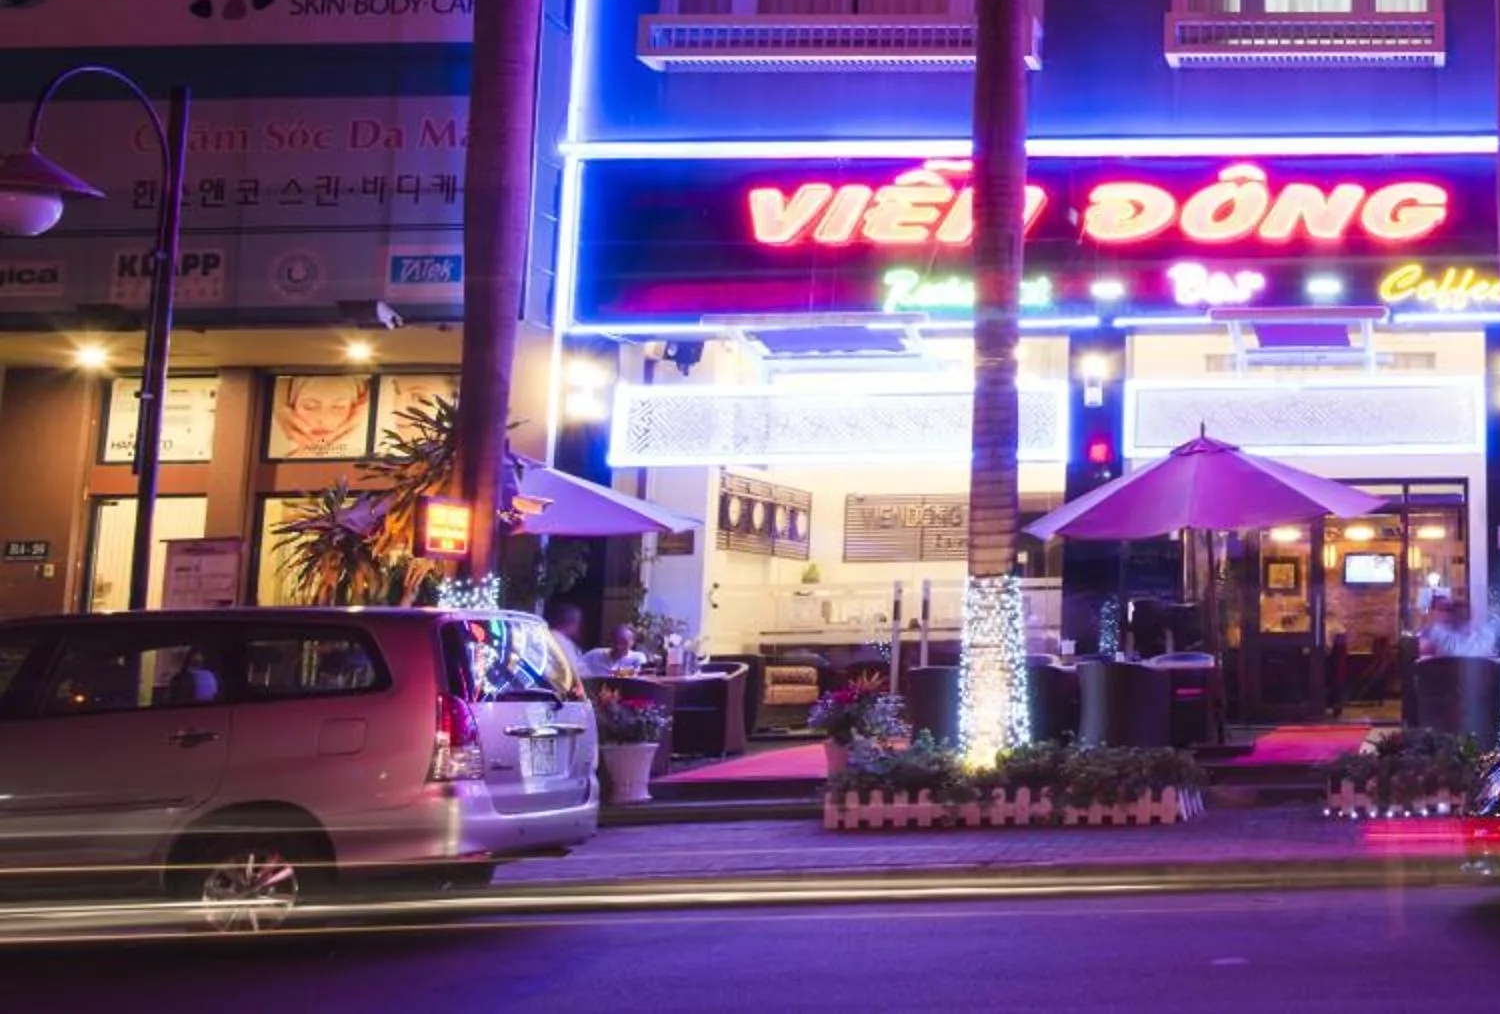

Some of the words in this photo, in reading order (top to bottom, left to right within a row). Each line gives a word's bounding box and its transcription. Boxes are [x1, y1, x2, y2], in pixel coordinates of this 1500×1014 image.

[132, 120, 247, 152] Căm
[265, 120, 332, 152] Sóc
[350, 120, 404, 149] Da
[417, 119, 470, 149] M
[132, 179, 260, 210] 한앤코
[1084, 163, 1447, 242] ĐÔNG
[117, 253, 222, 278] KLPP
[1168, 261, 1266, 306] Bar
